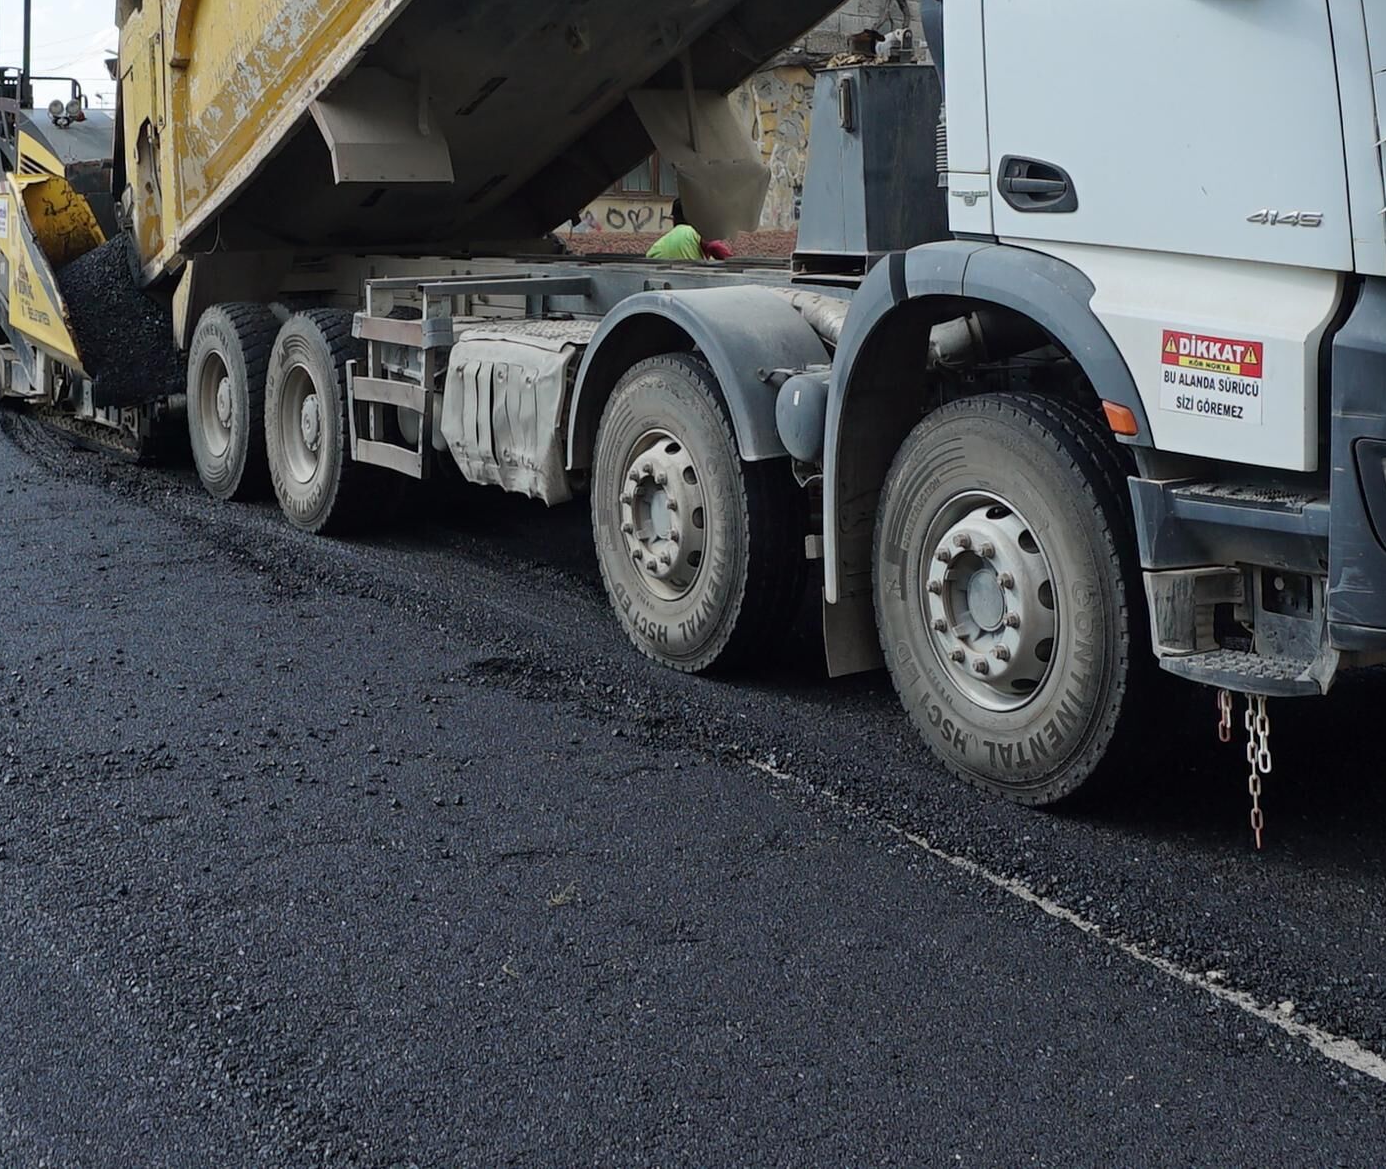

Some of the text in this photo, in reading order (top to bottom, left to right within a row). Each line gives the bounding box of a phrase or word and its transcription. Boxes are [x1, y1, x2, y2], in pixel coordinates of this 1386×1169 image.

[1246, 208, 1325, 228] 4145
[1178, 335, 1245, 363] DİKKAT
[1164, 370, 1260, 398] BU ALANDA SÜRÜCÜ
[1176, 393, 1244, 420] SİZİ GÖREMEZ
[678, 455, 727, 644] CONTINENTAL
[983, 580, 1095, 769] CONTINENTAL
